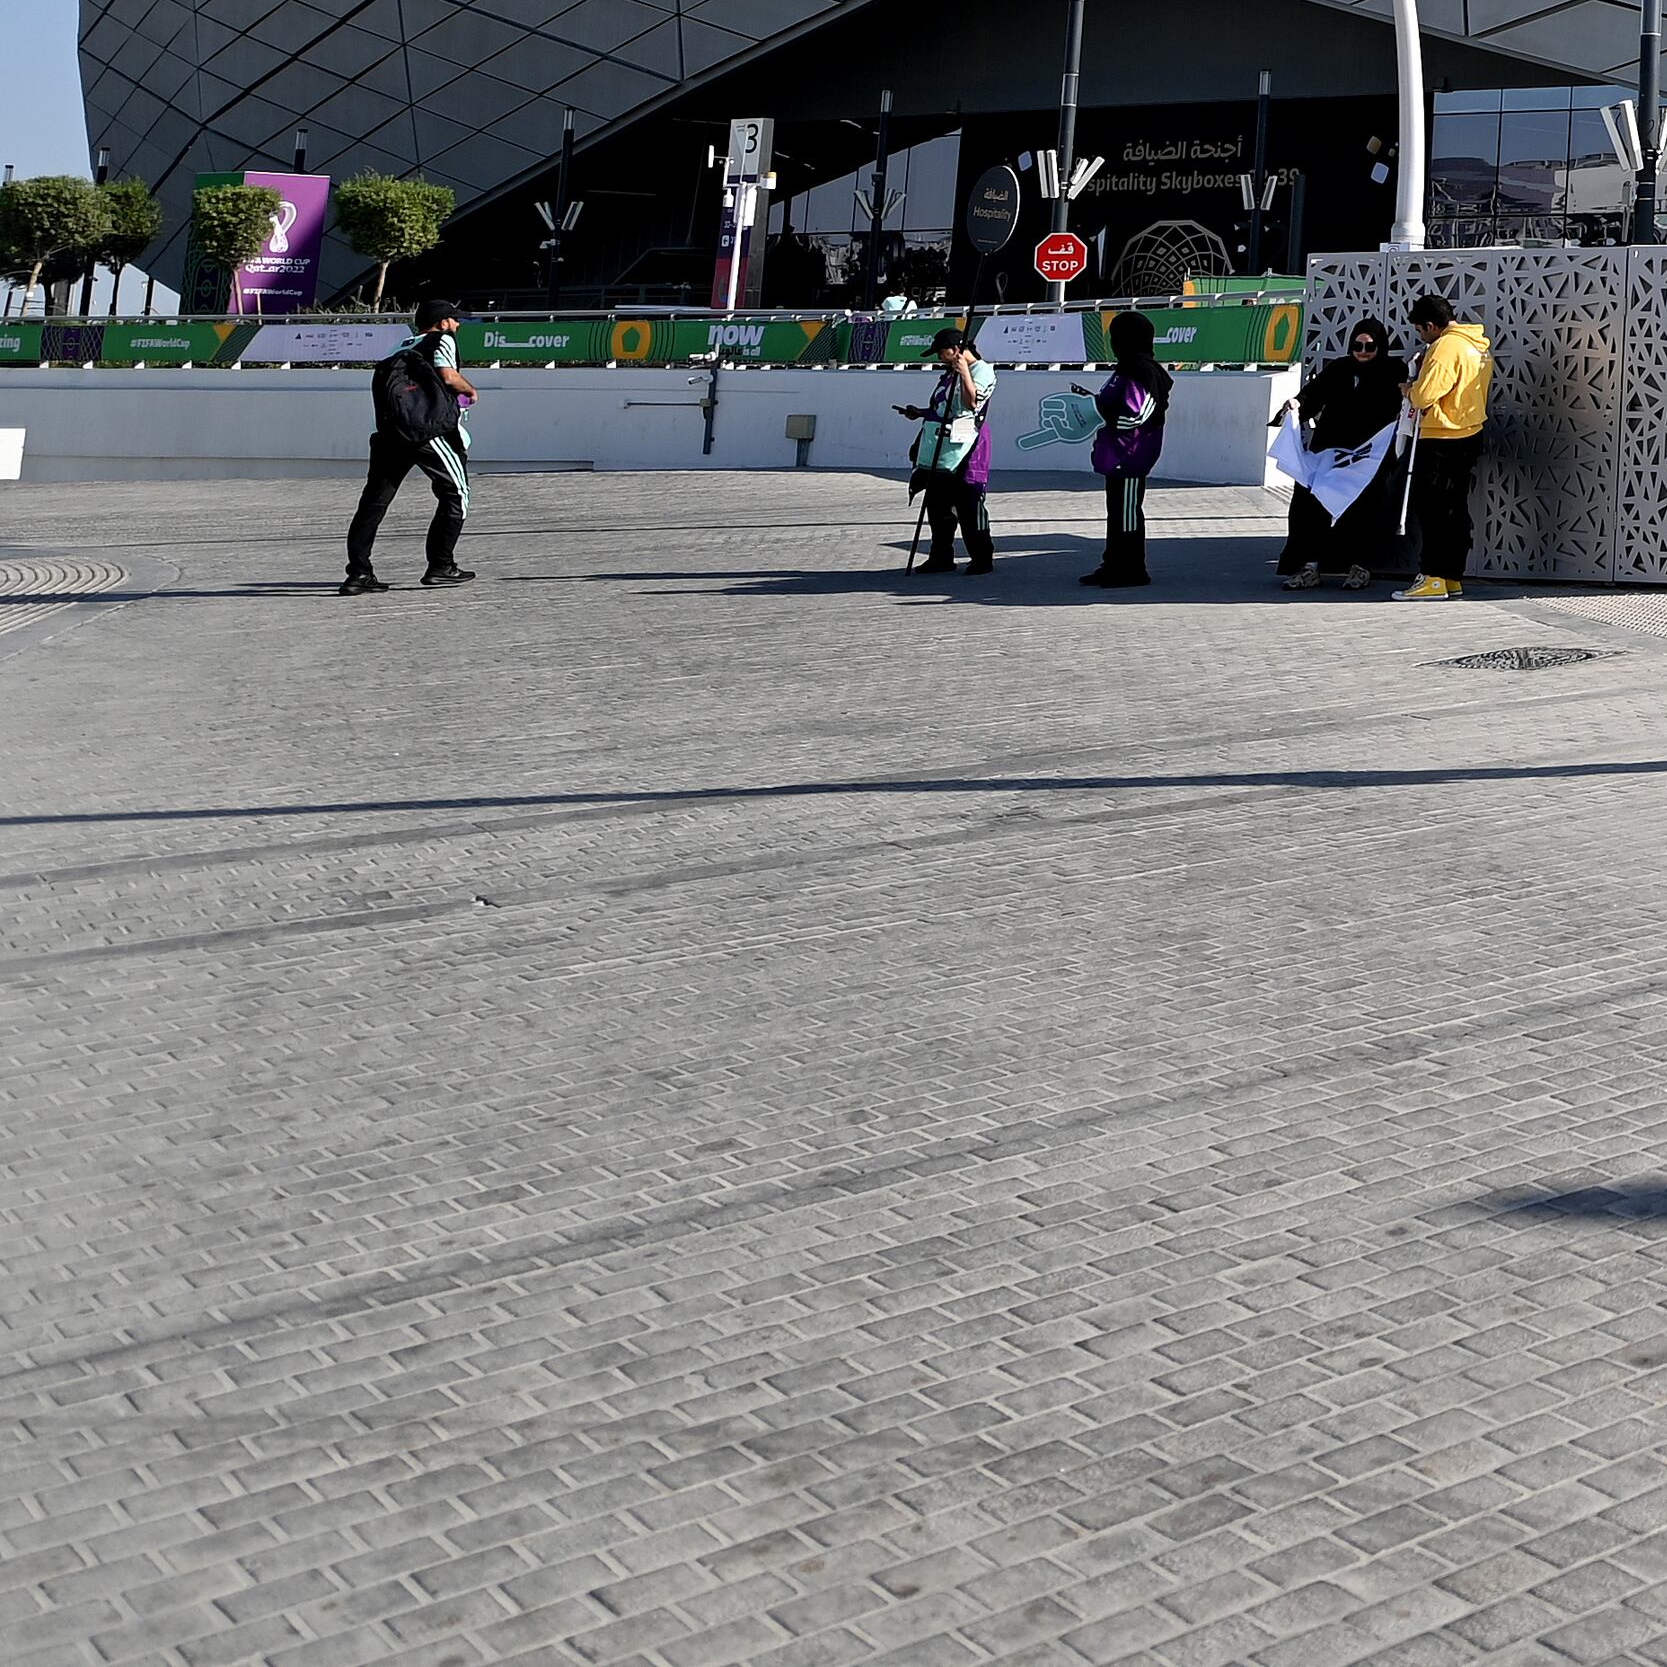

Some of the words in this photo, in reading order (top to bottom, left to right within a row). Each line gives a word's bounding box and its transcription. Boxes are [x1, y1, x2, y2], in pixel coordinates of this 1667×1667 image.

[745, 123, 759, 154] 3
[1123, 140, 1187, 166] الضيافة
[1190, 135, 1243, 163] أجنحة
[973, 206, 1011, 222] Hospitality
[1048, 242, 1074, 254] قف
[1042, 260, 1078, 271] STOP
[129, 337, 191, 350] #FIFAWorldCup
[707, 324, 765, 346] now
